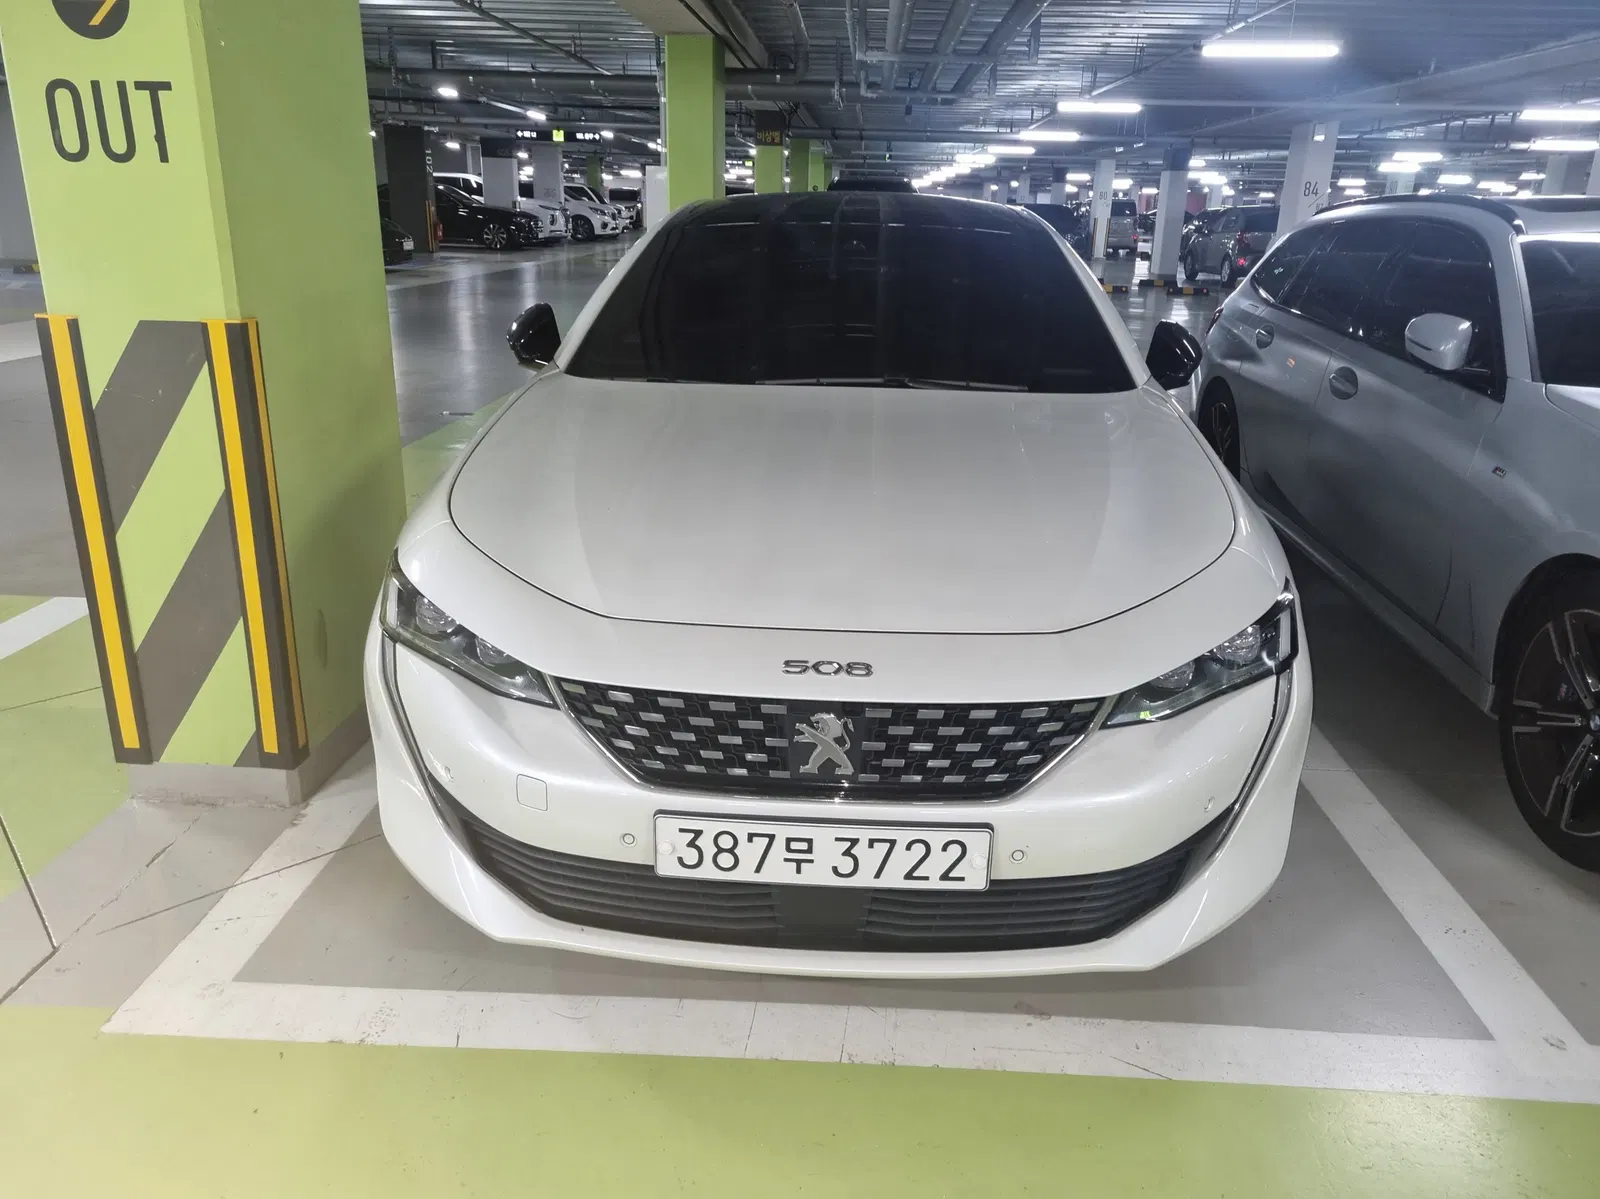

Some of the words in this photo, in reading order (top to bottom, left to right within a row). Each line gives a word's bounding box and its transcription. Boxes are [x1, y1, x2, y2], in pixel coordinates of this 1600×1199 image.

[45, 78, 172, 163] OUT
[756, 129, 781, 143] 비상벨
[425, 148, 433, 173] 102
[1303, 181, 1319, 197] 84
[781, 659, 874, 677] 508
[676, 827, 814, 875] 387무
[831, 836, 968, 882] 3722
